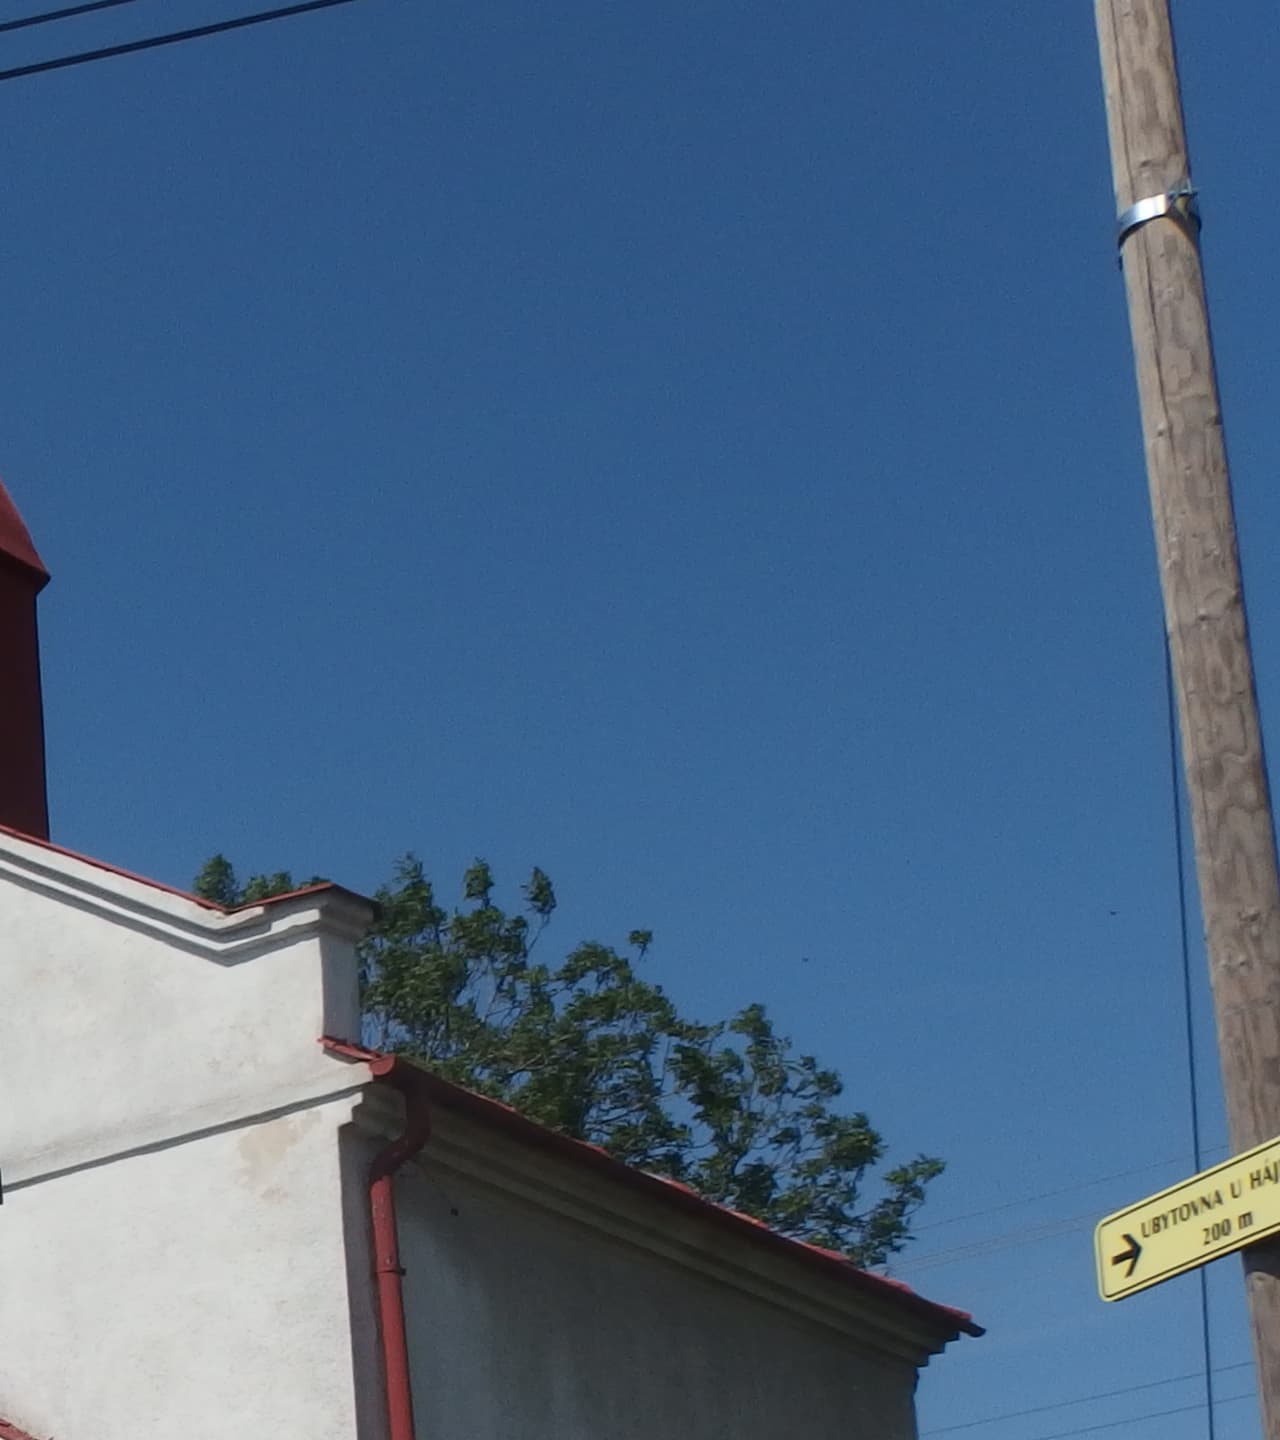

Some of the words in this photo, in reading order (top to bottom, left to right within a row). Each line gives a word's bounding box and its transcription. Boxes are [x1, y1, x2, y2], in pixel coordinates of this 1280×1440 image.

[1141, 1189, 1224, 1238] UBYTOVNA
[1230, 1180, 1242, 1199] U
[1249, 1158, 1280, 1190] HÁJ
[1202, 1218, 1232, 1245] 200
[1238, 1211, 1253, 1230] m
